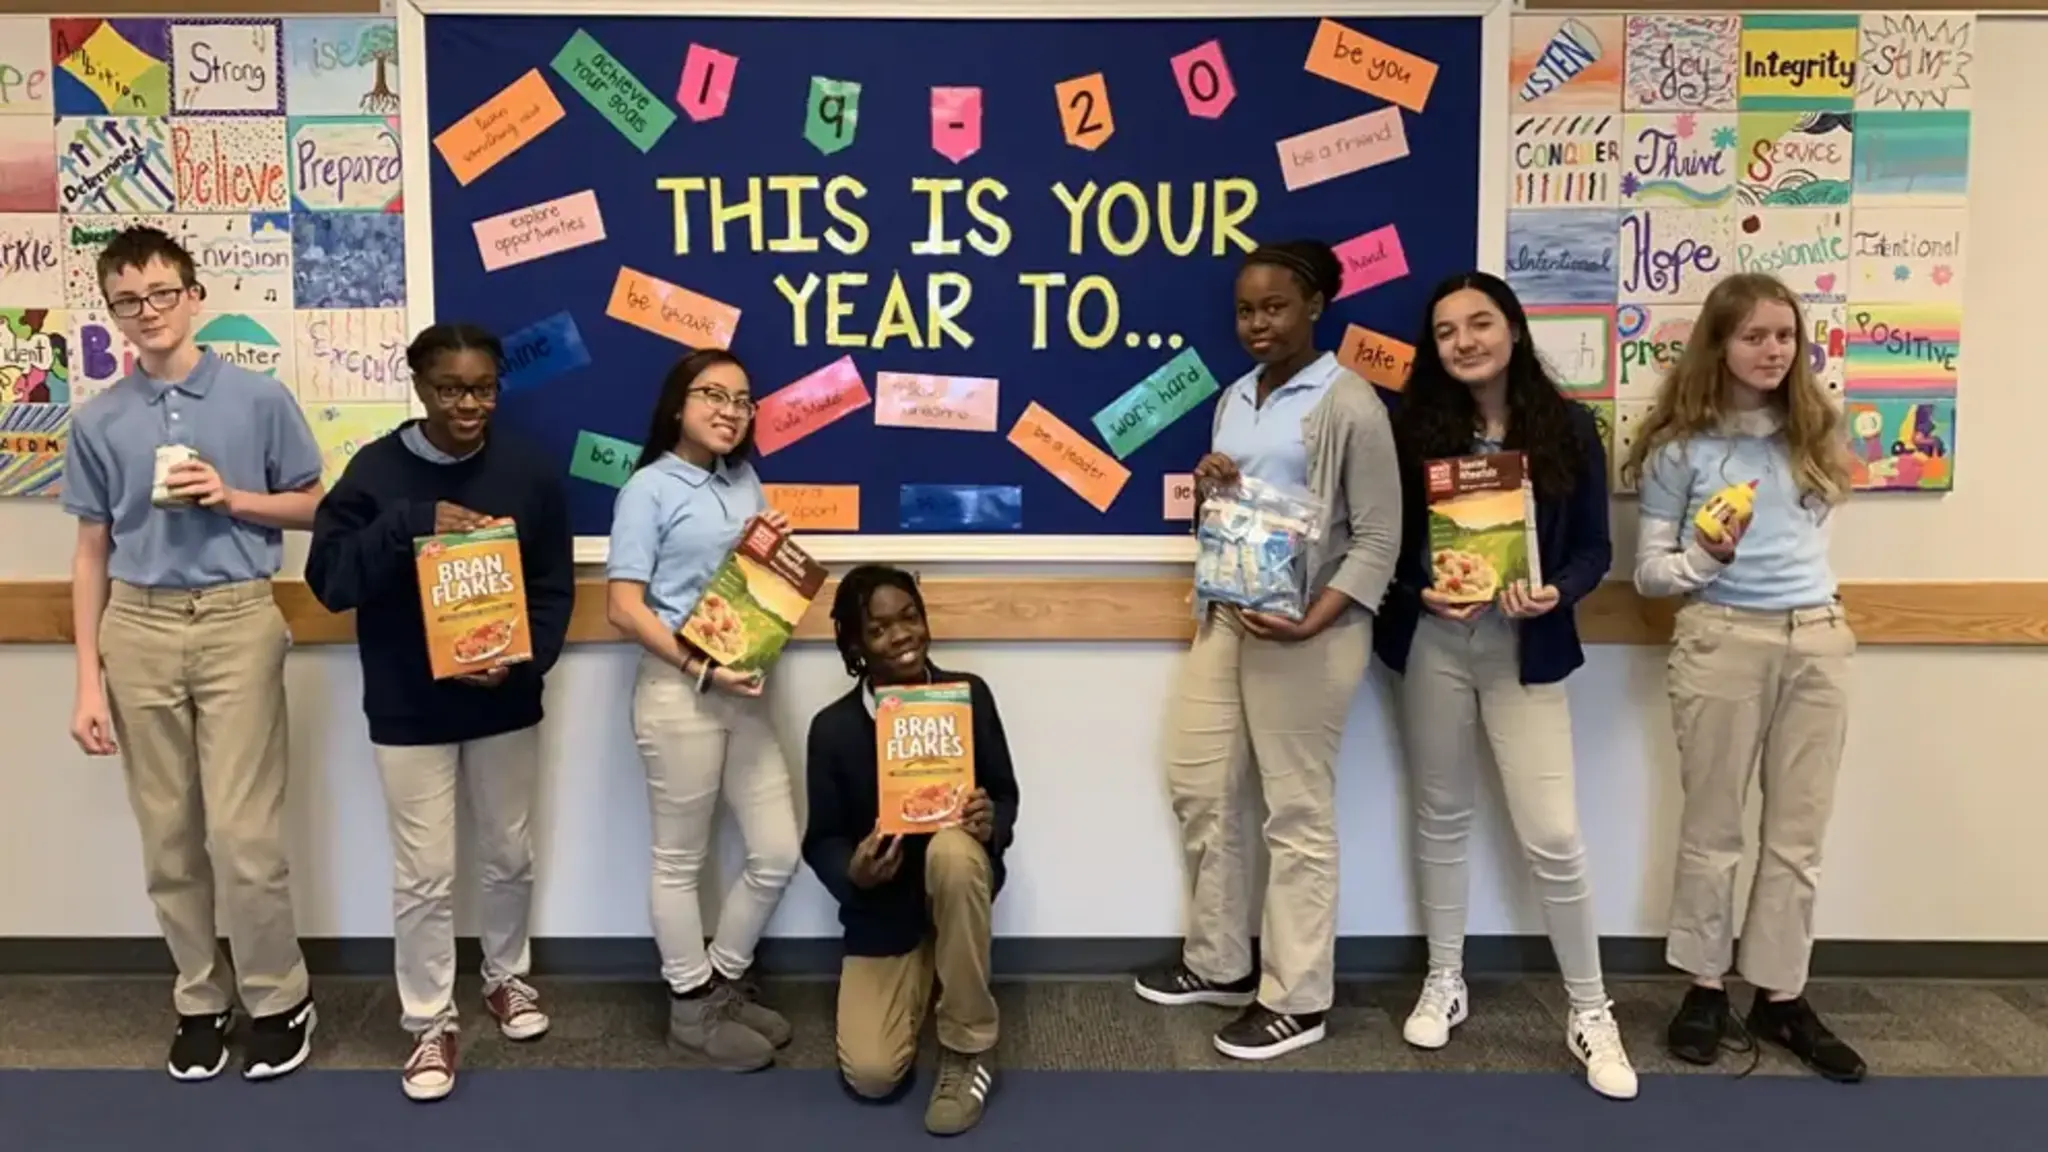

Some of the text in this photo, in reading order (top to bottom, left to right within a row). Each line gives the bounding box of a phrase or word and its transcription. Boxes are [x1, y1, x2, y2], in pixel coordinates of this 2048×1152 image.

[56, 29, 147, 108] Ambition
[189, 41, 265, 93] Strong
[592, 53, 650, 110] achieve
[1333, 31, 1411, 84] be you
[1519, 27, 1597, 102] LISTEN
[1659, 43, 1731, 105] Joy
[1744, 49, 1857, 88] Integrity
[607, 94, 648, 133] goals
[819, 96, 843, 138] 9
[1071, 91, 1103, 136] 2
[1188, 60, 1220, 102] 0
[63, 136, 144, 203] Determined
[171, 126, 286, 208] Believe
[296, 131, 403, 202] Prepared
[1291, 122, 1393, 168] be a friend
[1635, 128, 1724, 178] Thrive
[495, 217, 586, 257] opportunities
[510, 206, 560, 229] explore
[657, 176, 1258, 256] THIS IS YOUR
[0, 239, 58, 273] rkle
[182, 233, 289, 269] Envision
[1507, 244, 1612, 272] Intentional
[1621, 210, 1721, 294] Hope
[1737, 226, 1849, 273] Passionate
[626, 280, 716, 336] be brave
[773, 271, 1184, 349] YEAR TO...
[1353, 337, 1396, 370] take
[1856, 311, 1957, 371] POSITIVE
[1109, 364, 1200, 438] work hard
[589, 443, 616, 466] be
[1033, 425, 1107, 480] be a leader
[431, 572, 515, 608] FLAKES
[438, 553, 504, 584] BRAN
[886, 735, 965, 761] FLAKES
[893, 715, 956, 738] BRAN
